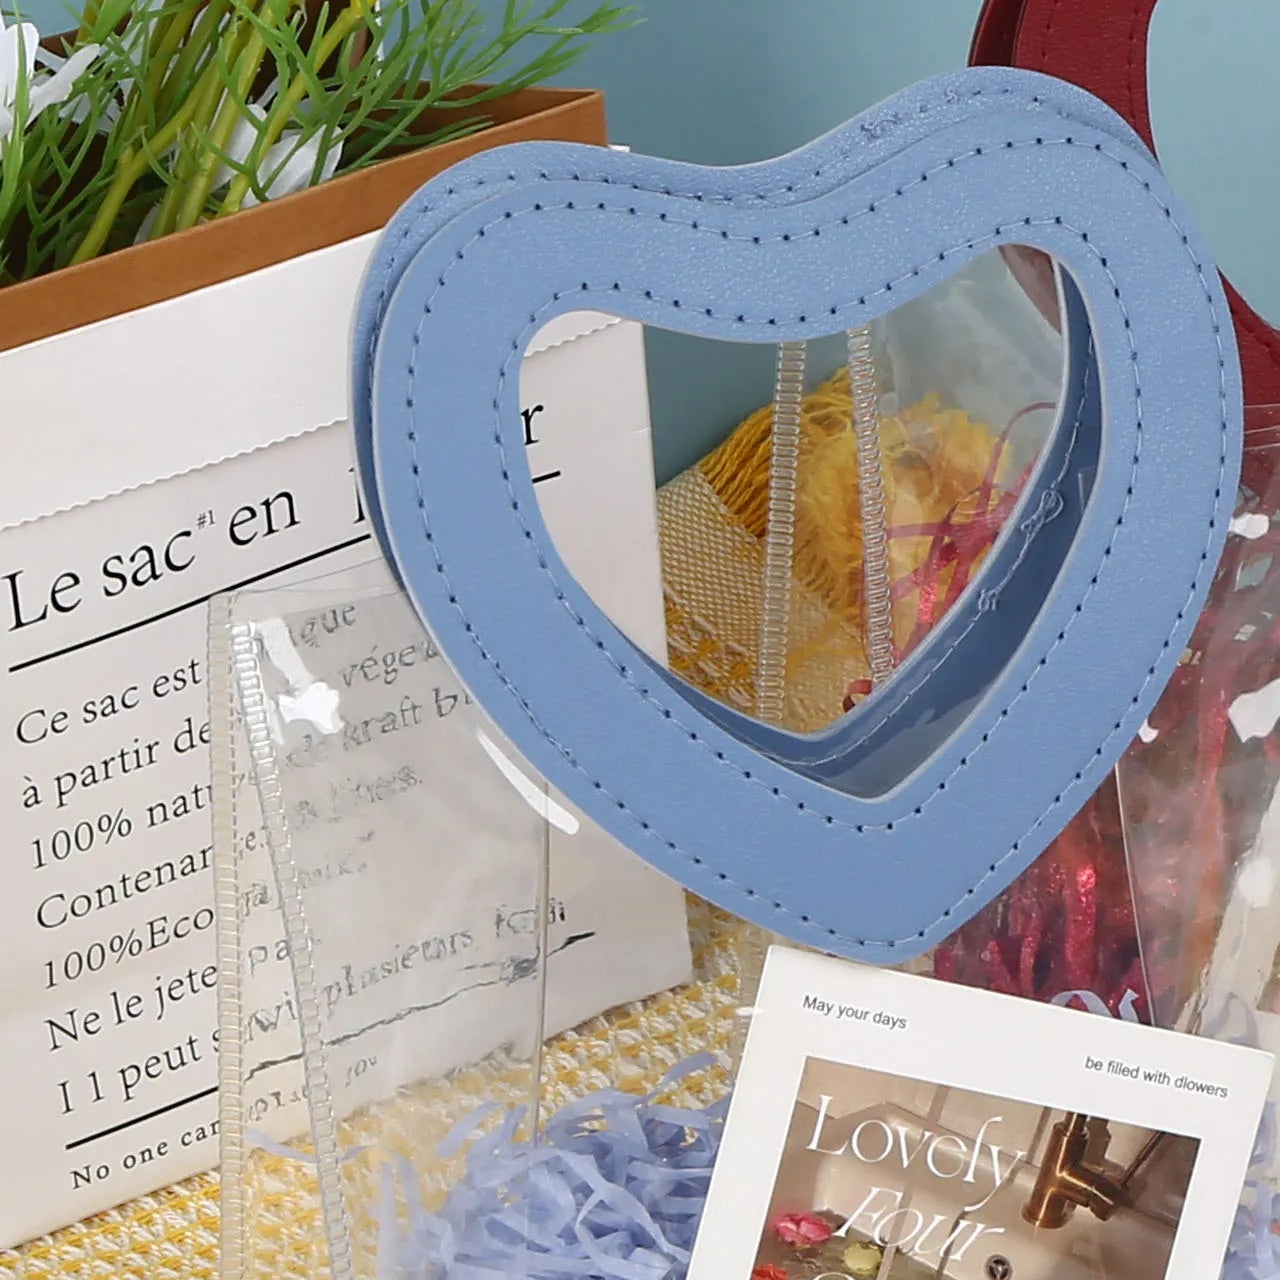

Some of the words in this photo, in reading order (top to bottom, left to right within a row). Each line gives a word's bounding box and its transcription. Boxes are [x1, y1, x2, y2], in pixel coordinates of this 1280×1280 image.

[2, 570, 83, 632] Le
[228, 489, 301, 547] en
[16, 708, 69, 745] Ce
[83, 685, 141, 724] sac
[152, 658, 202, 698] est
[22, 775, 42, 809] à
[54, 737, 160, 809] partir
[32, 808, 132, 870] 100%
[45, 1008, 102, 1051] Ne
[110, 991, 144, 1026] le
[803, 995, 833, 1015] May
[836, 1004, 870, 1023] your
[872, 1008, 908, 1030] days
[119, 1035, 202, 1102] peut
[1085, 1056, 1103, 1072] be
[1107, 1060, 1140, 1079] filled
[1143, 1070, 1171, 1087] with
[1174, 1075, 1229, 1099] dlowers
[70, 1164, 110, 1189] No
[123, 1141, 169, 1169] one
[806, 1095, 1027, 1211] Lovely
[833, 1186, 1006, 1262] Four
